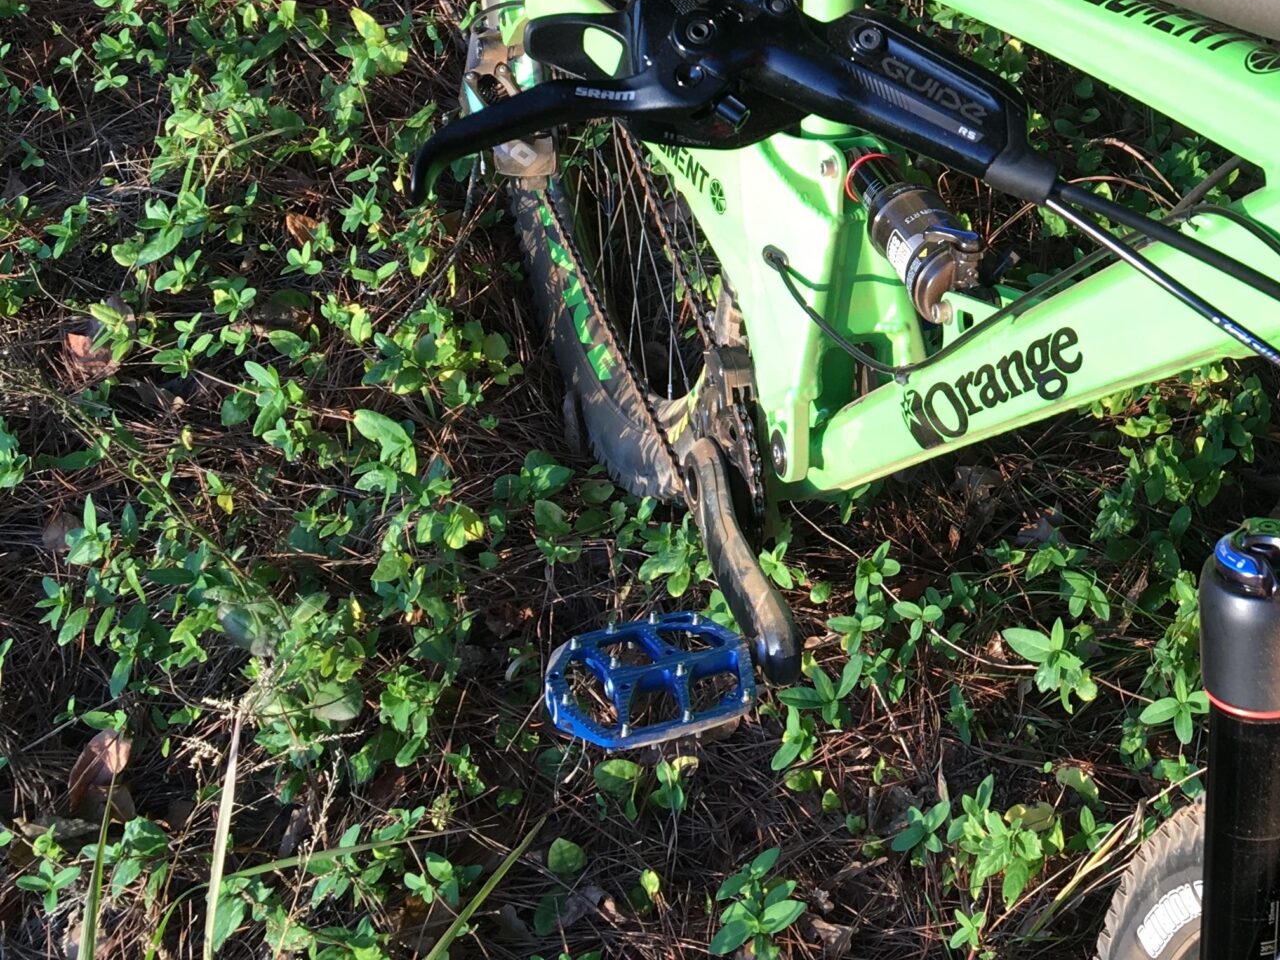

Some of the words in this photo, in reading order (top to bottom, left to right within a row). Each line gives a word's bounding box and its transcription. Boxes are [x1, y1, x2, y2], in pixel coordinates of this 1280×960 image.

[575, 87, 635, 100] SRAM
[881, 57, 987, 125] GUIDE
[958, 125, 977, 140] RS
[920, 326, 1083, 439] Orange
